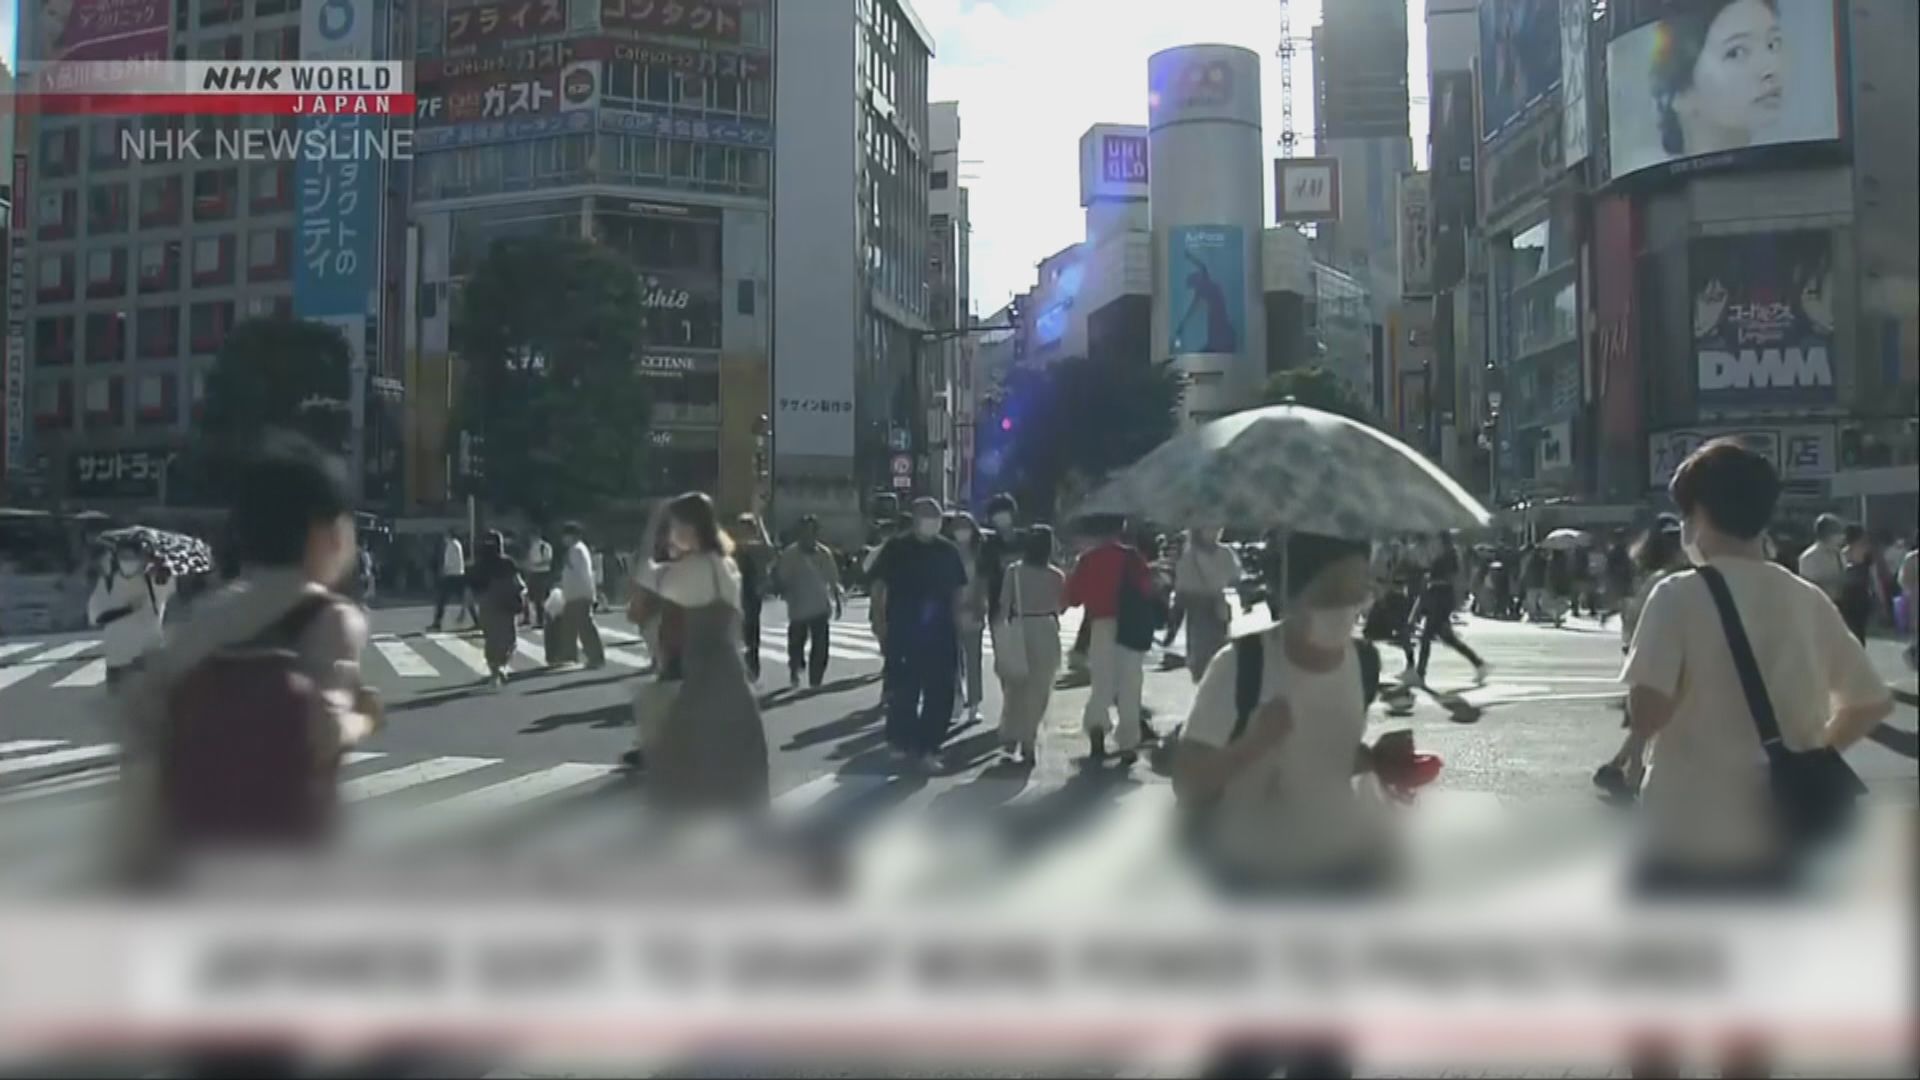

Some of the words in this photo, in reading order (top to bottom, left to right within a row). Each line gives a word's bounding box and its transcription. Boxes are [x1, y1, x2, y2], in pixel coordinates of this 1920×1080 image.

[482, 80, 553, 117] ガスト
[1698, 346, 1832, 390] DMM
